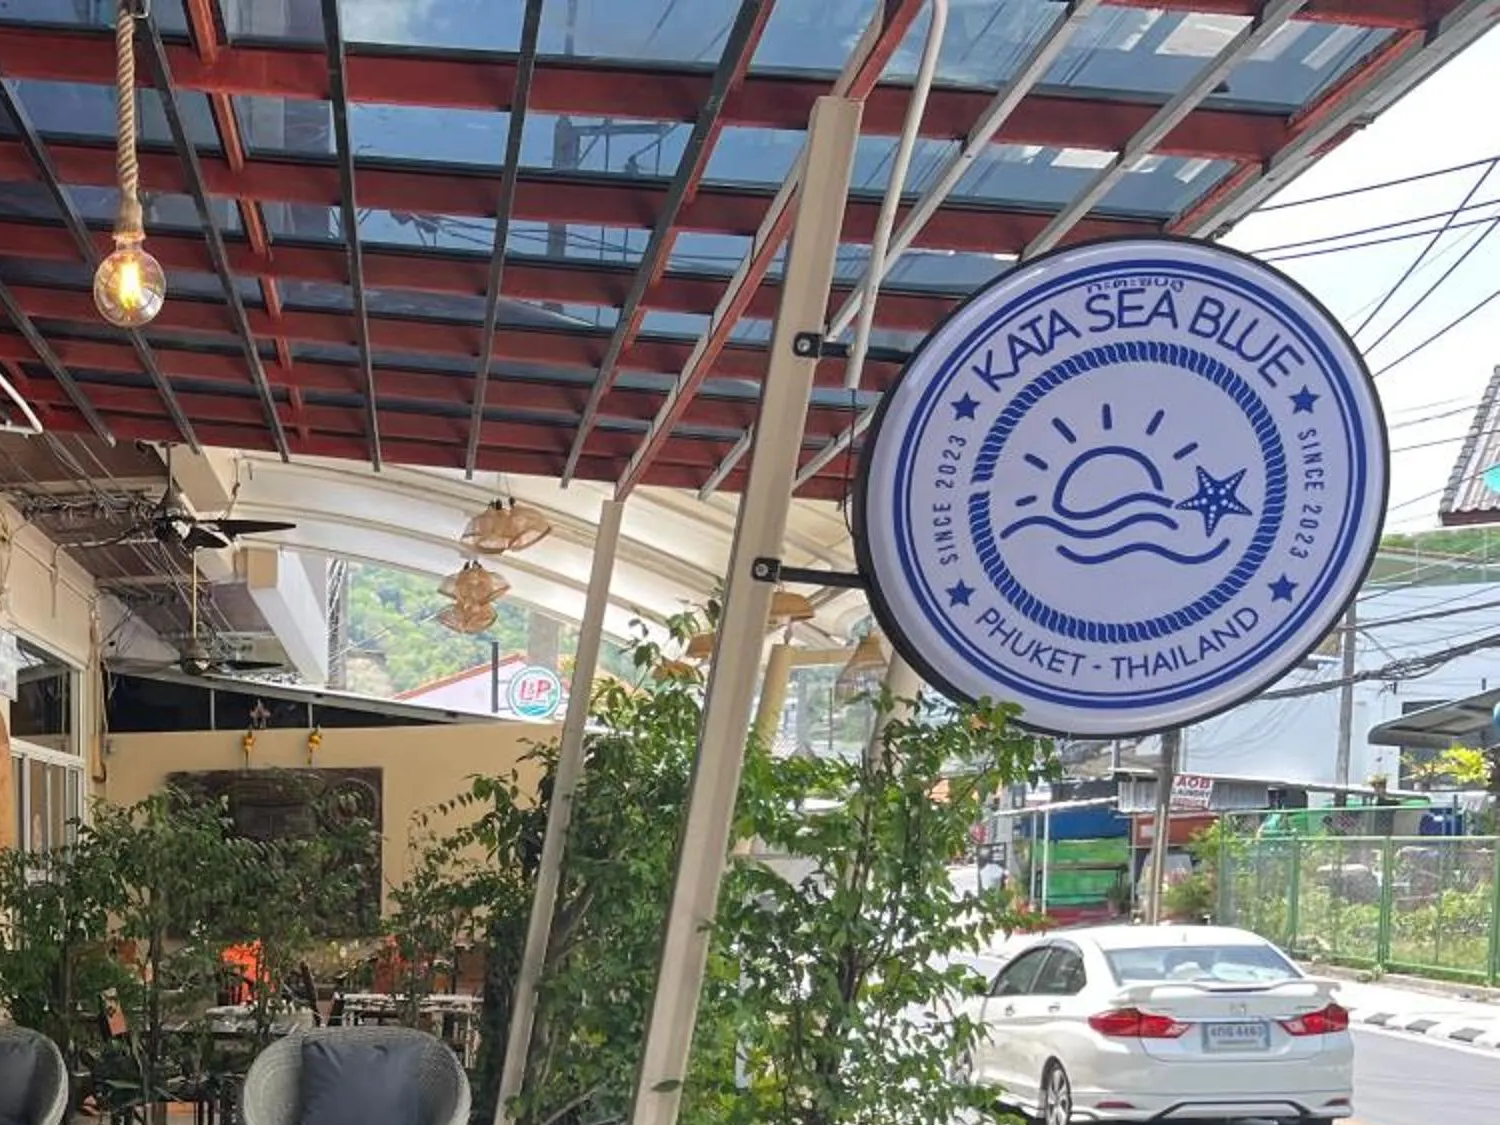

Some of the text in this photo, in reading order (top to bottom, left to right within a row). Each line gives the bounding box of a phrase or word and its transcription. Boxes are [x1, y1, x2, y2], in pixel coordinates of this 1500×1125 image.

[971, 287, 1306, 393] KATA SEA BLUE
[932, 434, 966, 566] SINCE 2023
[1289, 427, 1326, 560] SINCE 2023
[975, 607, 1087, 678] PHUKET
[1110, 605, 1260, 680] THAILAND
